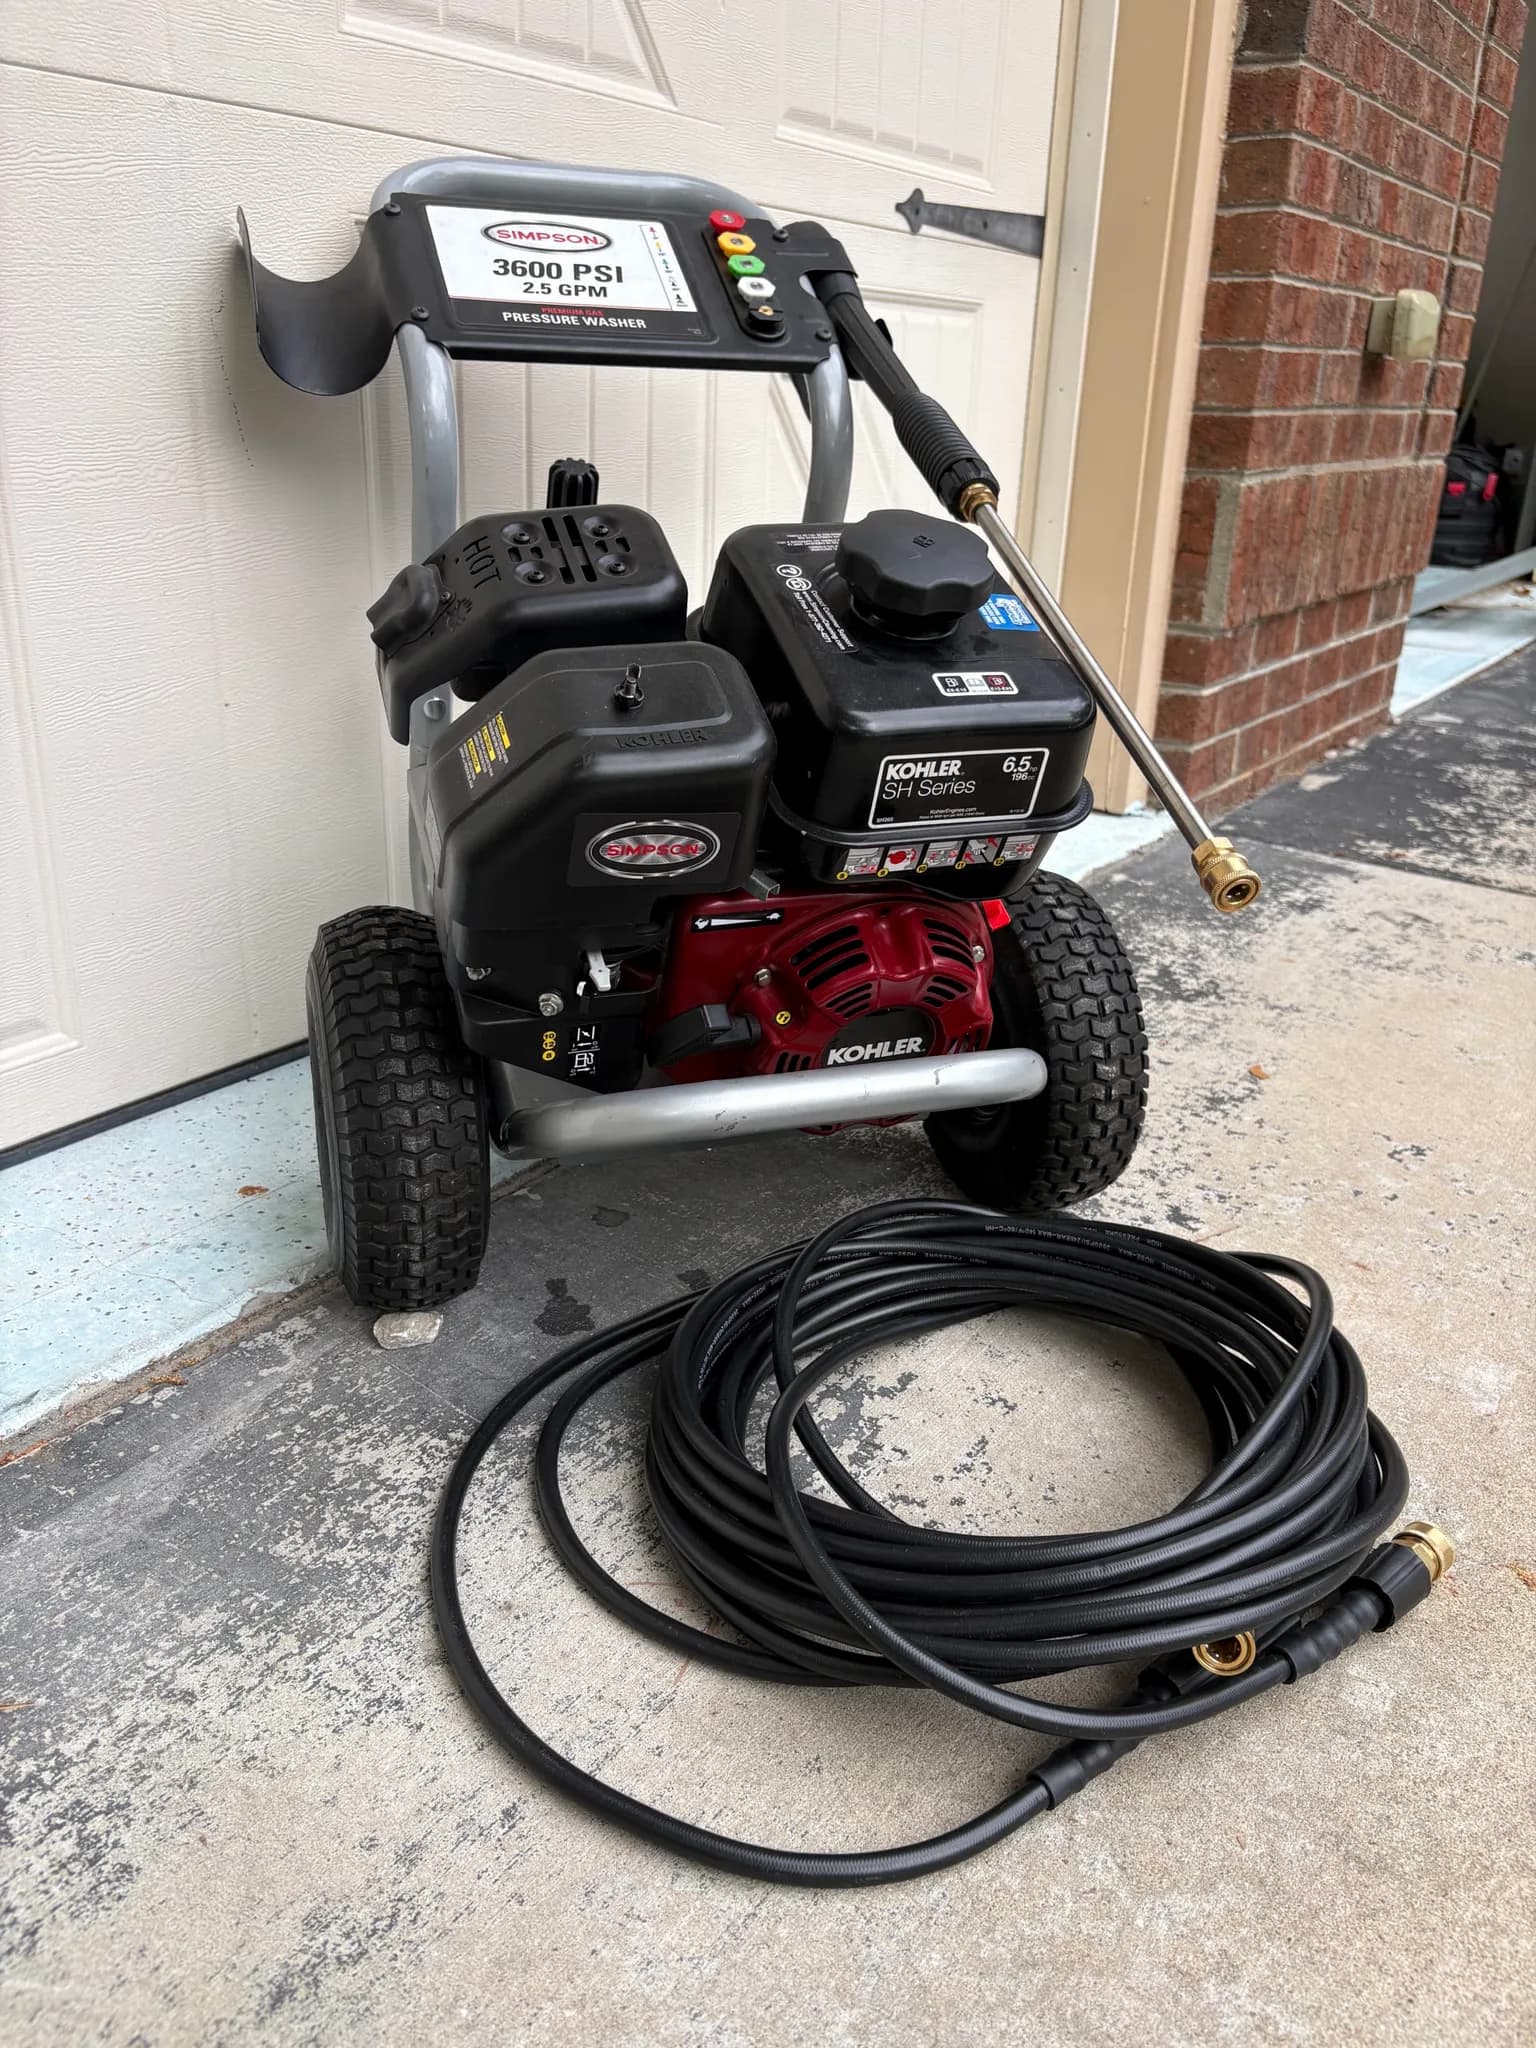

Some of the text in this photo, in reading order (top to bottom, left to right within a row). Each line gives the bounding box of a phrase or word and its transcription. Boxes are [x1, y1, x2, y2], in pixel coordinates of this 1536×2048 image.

[496, 229, 600, 245] SIMPSON
[492, 258, 624, 283] 3600 PSI
[522, 282, 608, 298] 2.5 GPM
[502, 311, 647, 329] PRESSURE WASHER
[541, 306, 584, 316] PREMIUM
[462, 535, 502, 589] HOT
[811, 590, 854, 647] Contact Customer Support
[616, 729, 708, 748] KOHLER
[886, 759, 962, 781] KOHLER
[1002, 755, 1032, 773] 6.5
[1011, 772, 1028, 781] 196
[882, 778, 977, 800] SH Series
[607, 844, 699, 857] SIMPSON
[827, 1036, 923, 1066] KOHLER
